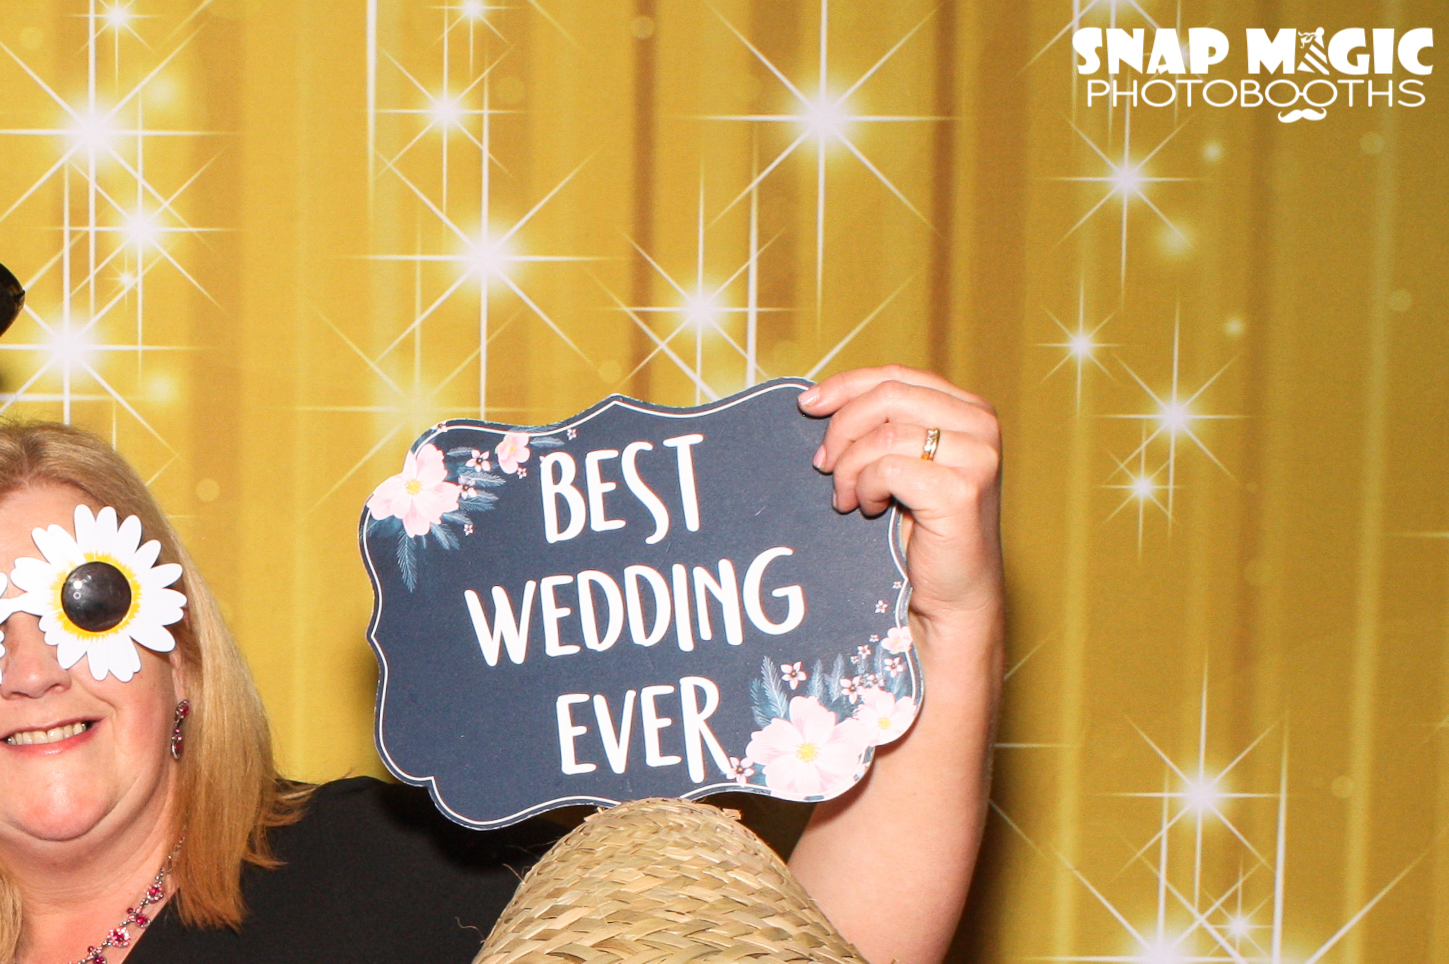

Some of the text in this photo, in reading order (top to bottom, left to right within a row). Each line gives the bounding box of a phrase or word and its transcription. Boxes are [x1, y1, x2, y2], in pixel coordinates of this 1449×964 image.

[540, 434, 703, 543] BEST
[464, 547, 805, 666] WEDDING
[556, 676, 731, 783] EVER
